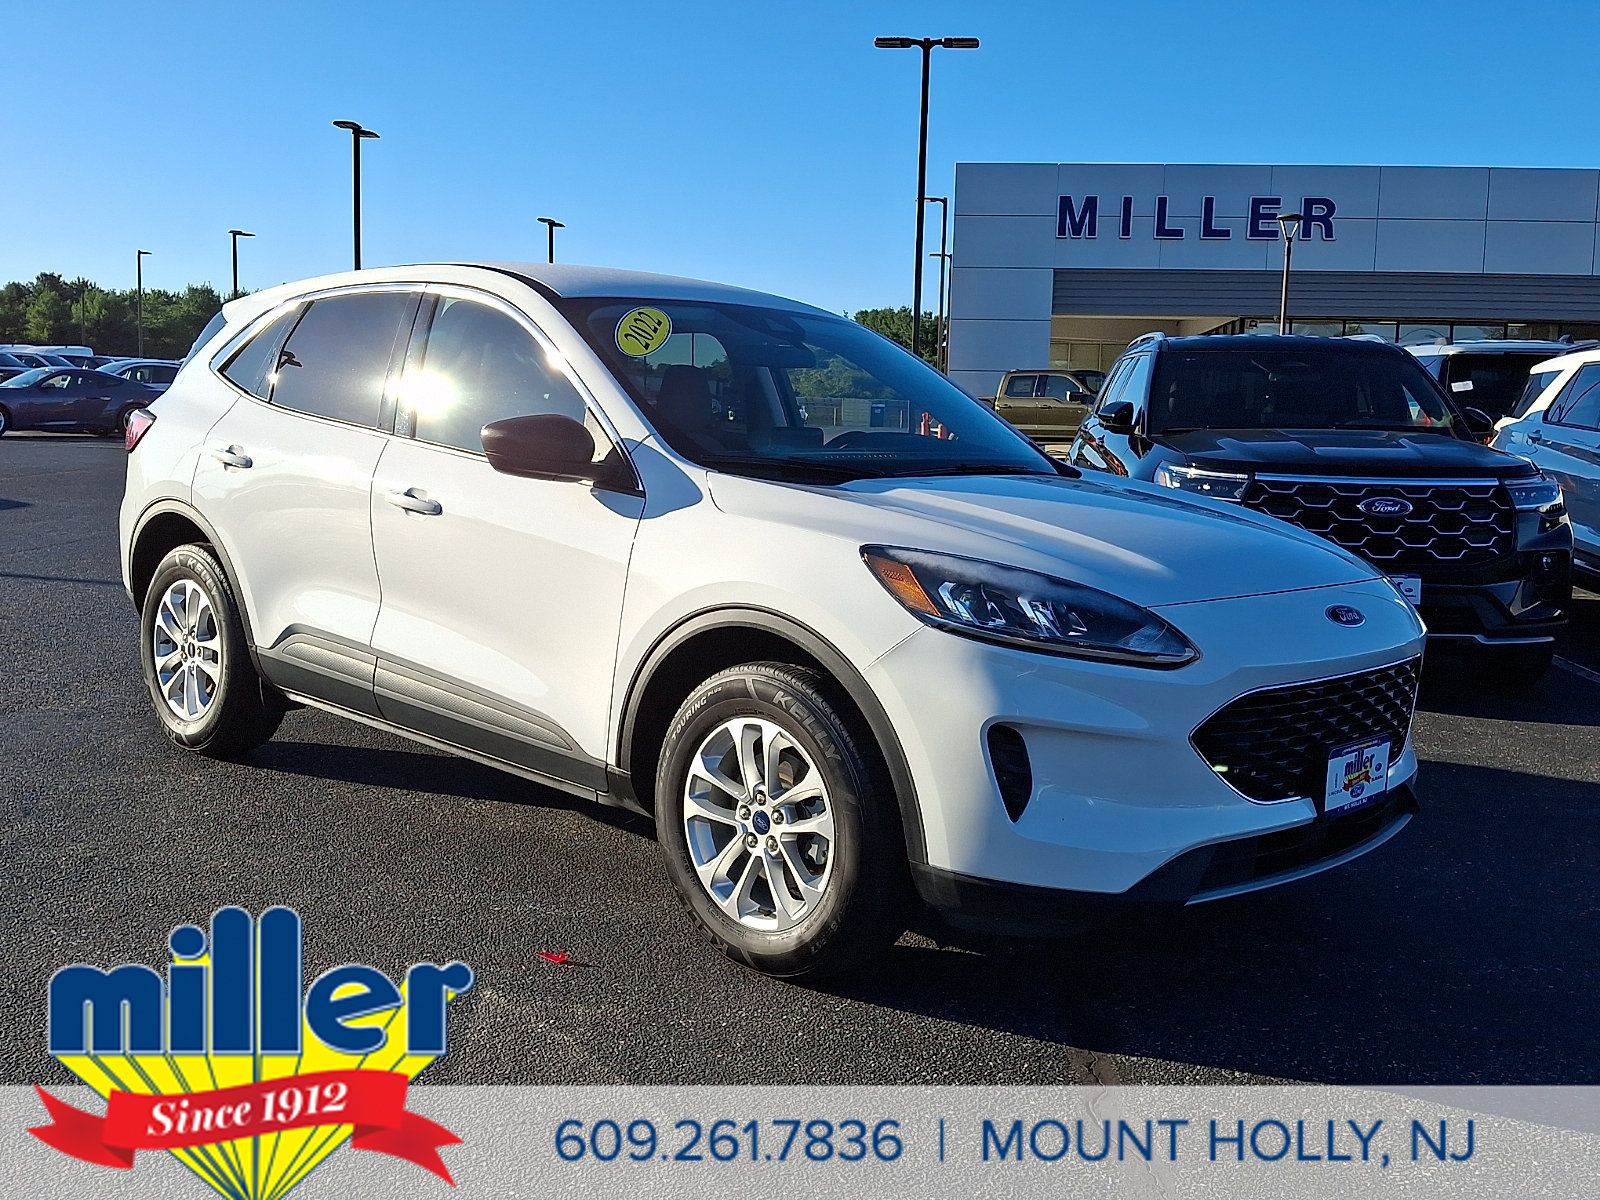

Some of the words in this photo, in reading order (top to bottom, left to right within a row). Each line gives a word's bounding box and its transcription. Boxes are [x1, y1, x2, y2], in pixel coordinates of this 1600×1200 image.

[1056, 195, 1337, 241] MILLER
[624, 311, 663, 351] 2022
[187, 557, 218, 596] KELLY
[671, 696, 707, 741] TOURING
[707, 686, 722, 697] PLUS
[772, 690, 842, 762] KELLY
[1344, 749, 1376, 777] miller
